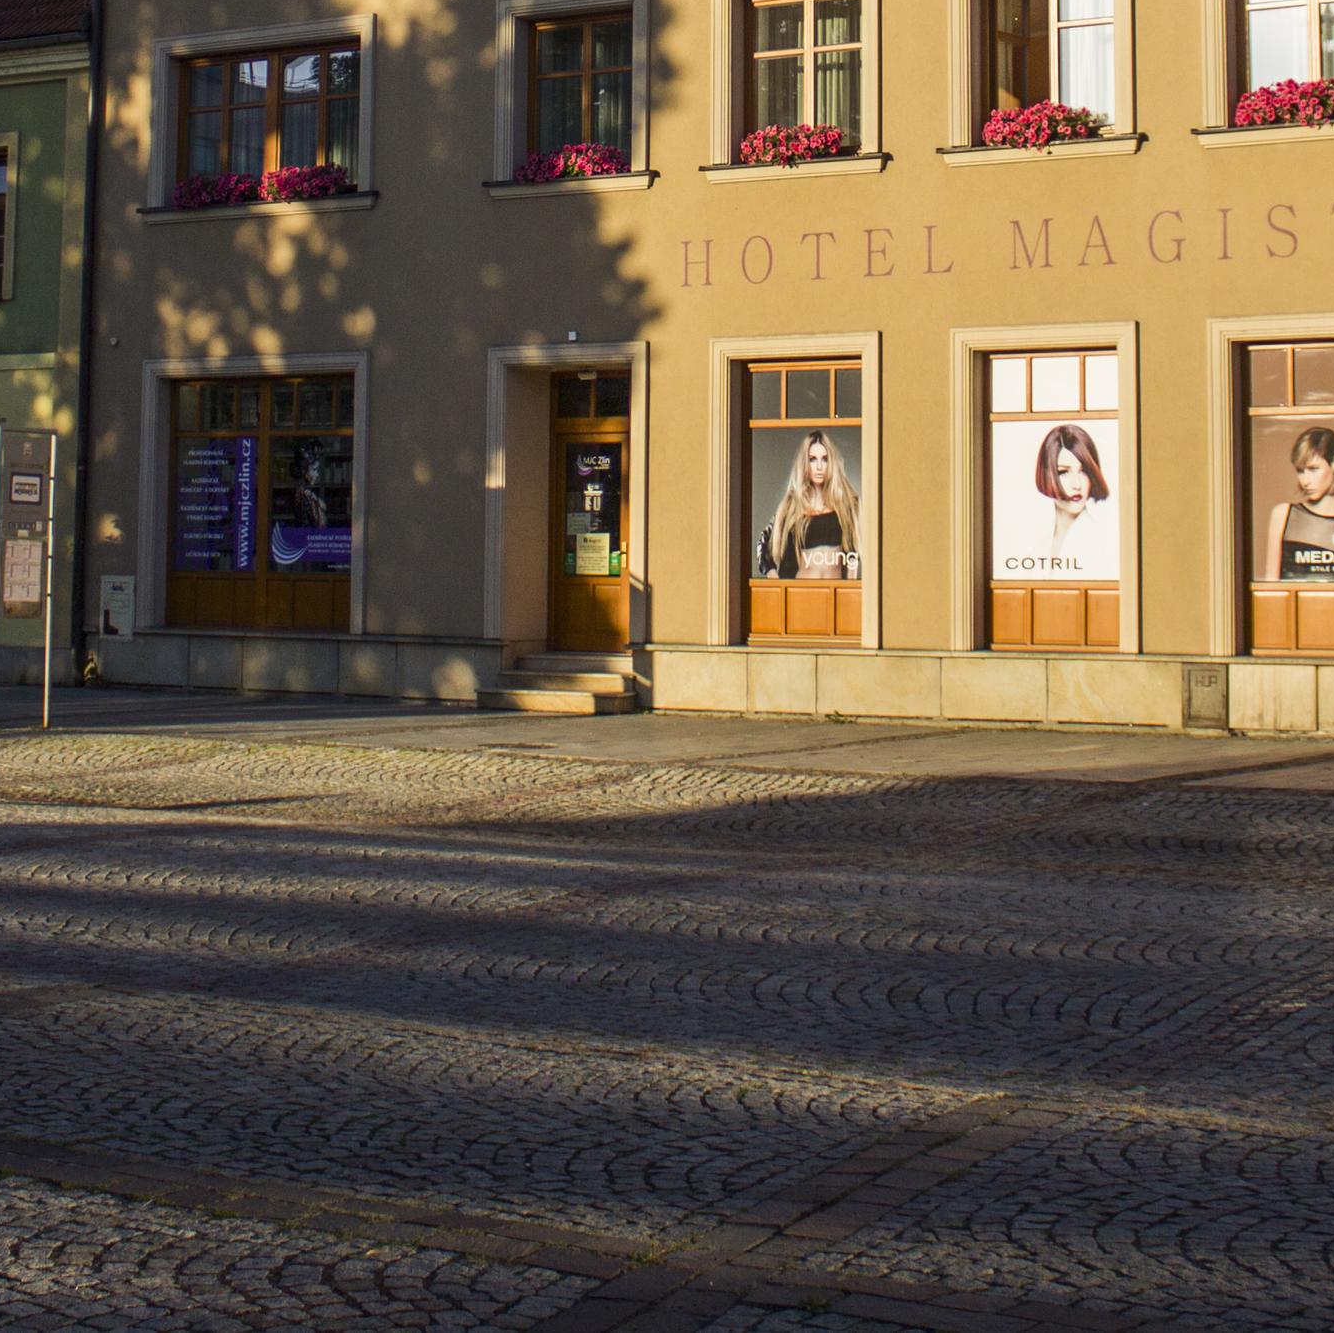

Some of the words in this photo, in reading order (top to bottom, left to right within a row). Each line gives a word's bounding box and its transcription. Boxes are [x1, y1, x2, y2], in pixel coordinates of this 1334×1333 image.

[680, 224, 954, 288] HOTEL
[237, 437, 252, 568] www.mjczlin.cz
[802, 551, 859, 569] young
[1005, 557, 1083, 570] COTRIL
